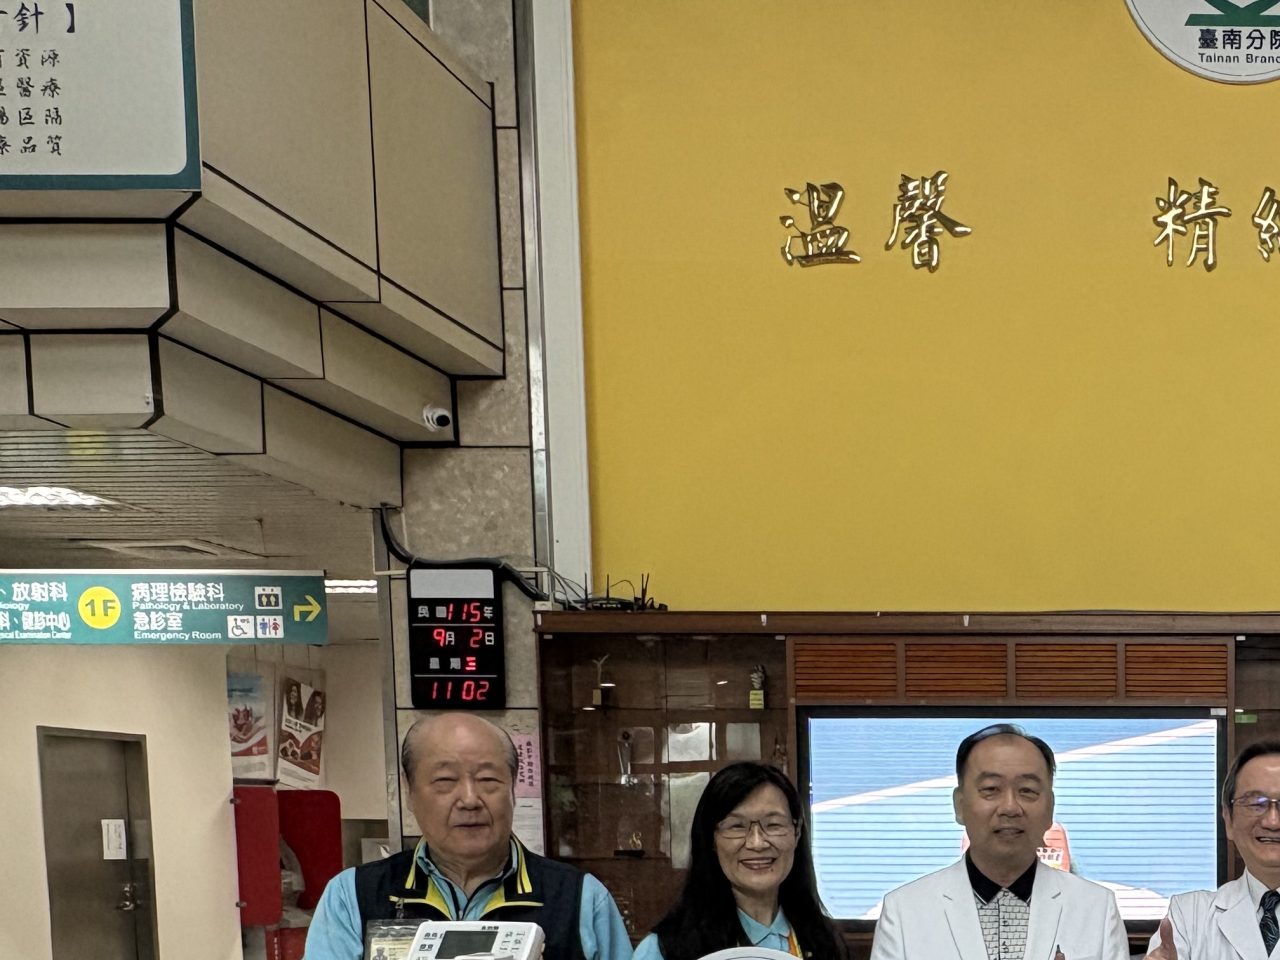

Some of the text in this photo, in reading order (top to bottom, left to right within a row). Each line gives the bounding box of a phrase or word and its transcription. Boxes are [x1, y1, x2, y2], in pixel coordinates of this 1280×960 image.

[0, 3, 75, 34] 針】
[0, 48, 61, 69] 資源
[1198, 53, 1240, 64] Tainan
[779, 171, 972, 273] 溫馨
[131, 582, 225, 602] 病理檢驗科
[84, 598, 117, 617] 1F
[132, 602, 181, 611] Pathology
[192, 602, 244, 612] Laboratory
[133, 612, 183, 631] 急診室
[134, 631, 222, 641] Emergency Room
